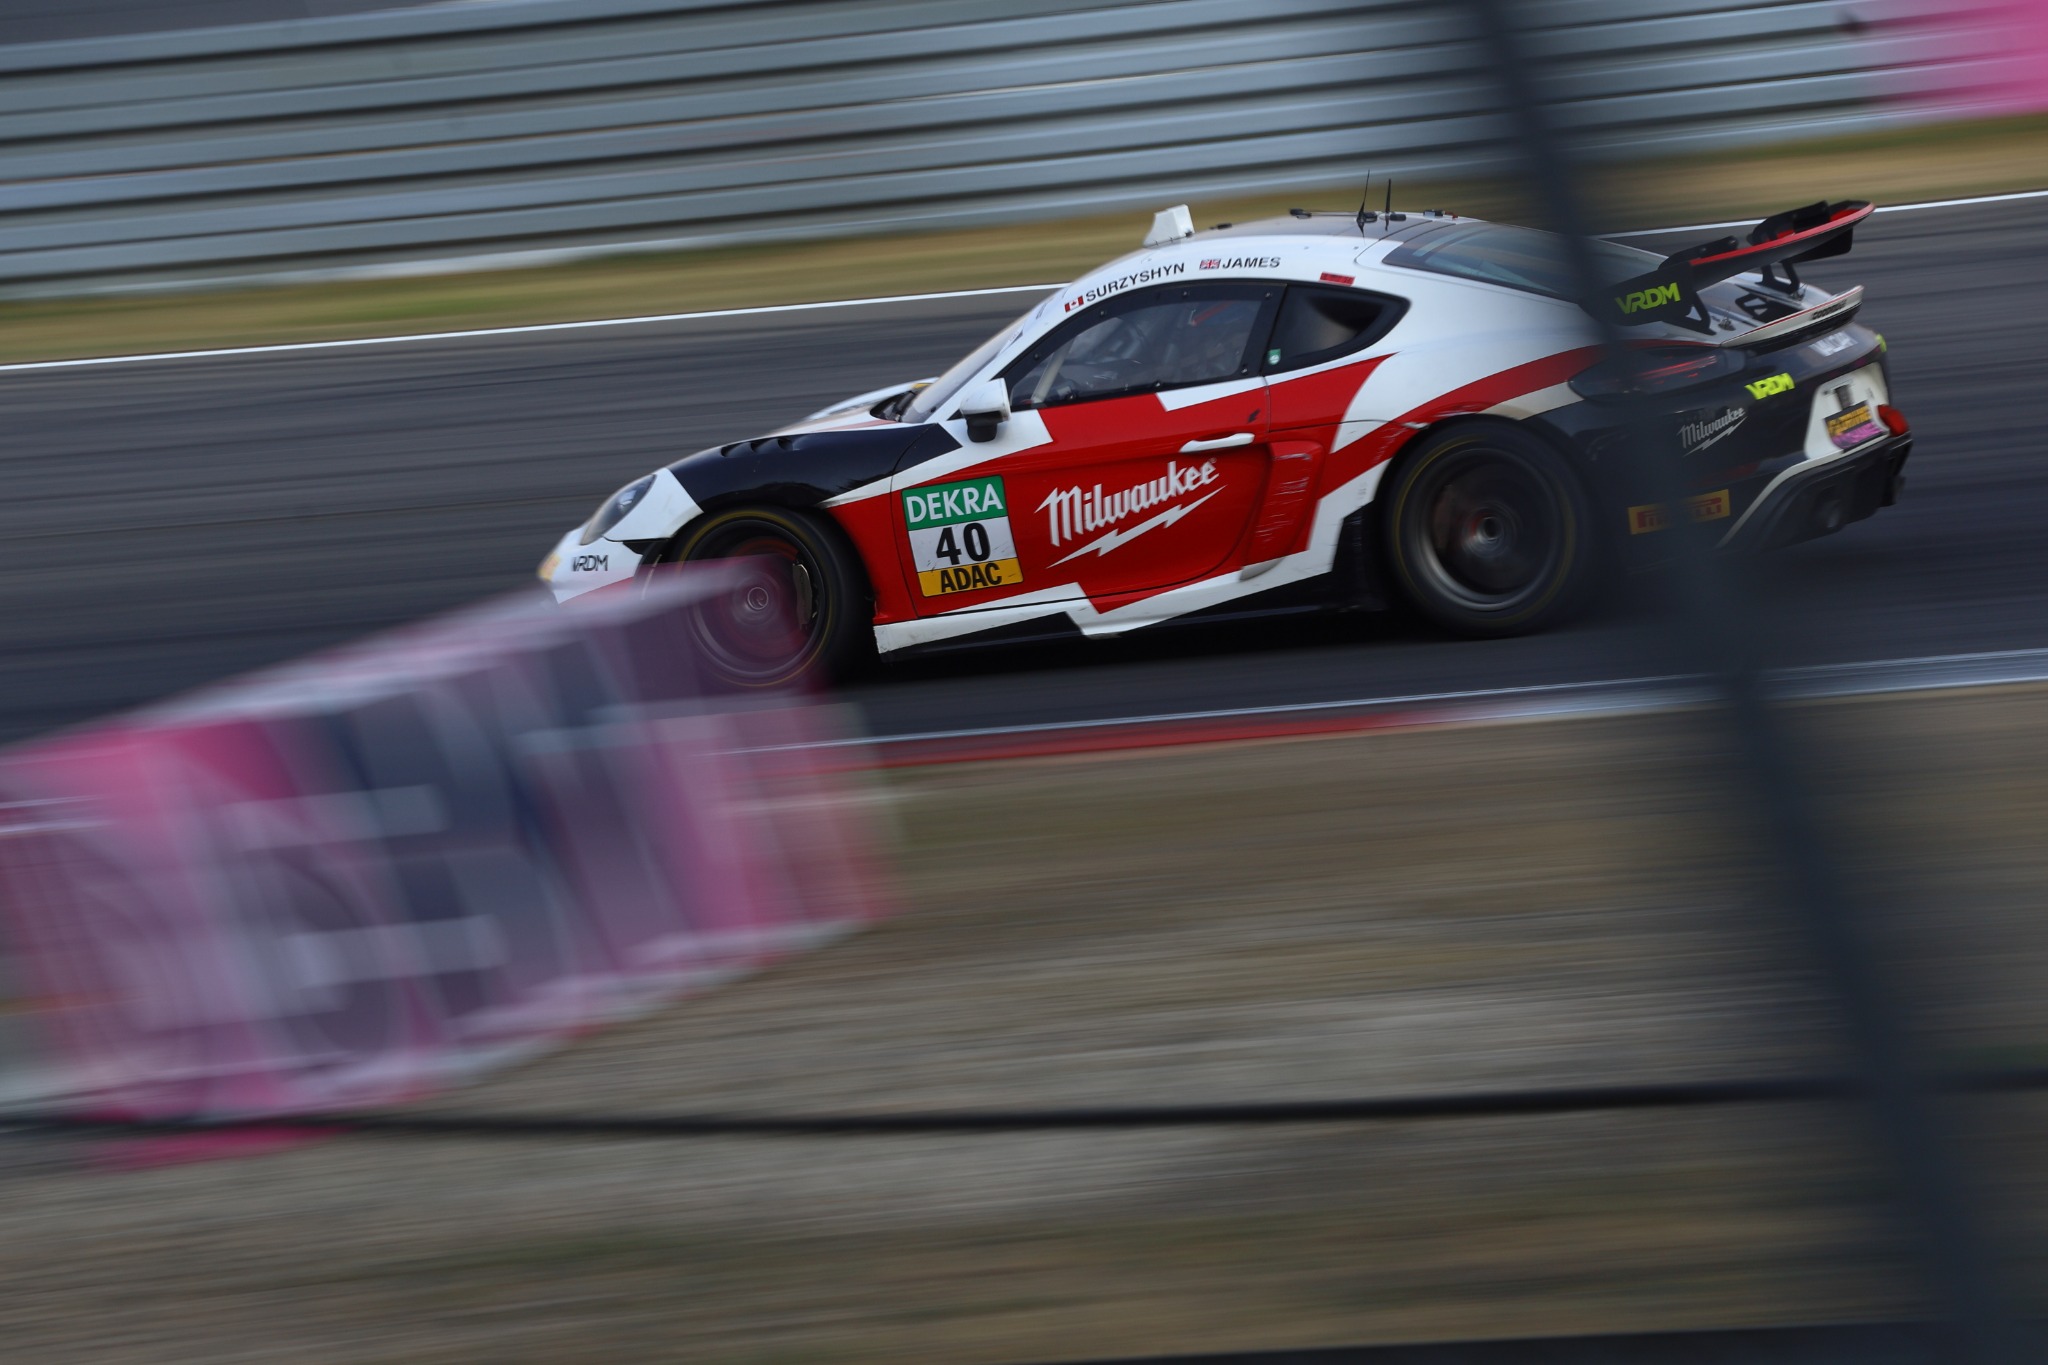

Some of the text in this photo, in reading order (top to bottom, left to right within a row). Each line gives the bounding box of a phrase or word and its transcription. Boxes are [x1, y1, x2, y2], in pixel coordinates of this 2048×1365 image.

[1222, 256, 1281, 269] JAMES
[1086, 263, 1185, 302] SURZYSHYN
[1615, 283, 1681, 314] VRDM
[1676, 407, 1746, 449] Milwaukee
[906, 483, 1004, 523] DEKRA
[1034, 460, 1219, 547] Milwaukee
[936, 522, 991, 565] 40
[572, 555, 609, 572] VRDM
[940, 562, 1003, 593] ADAC
